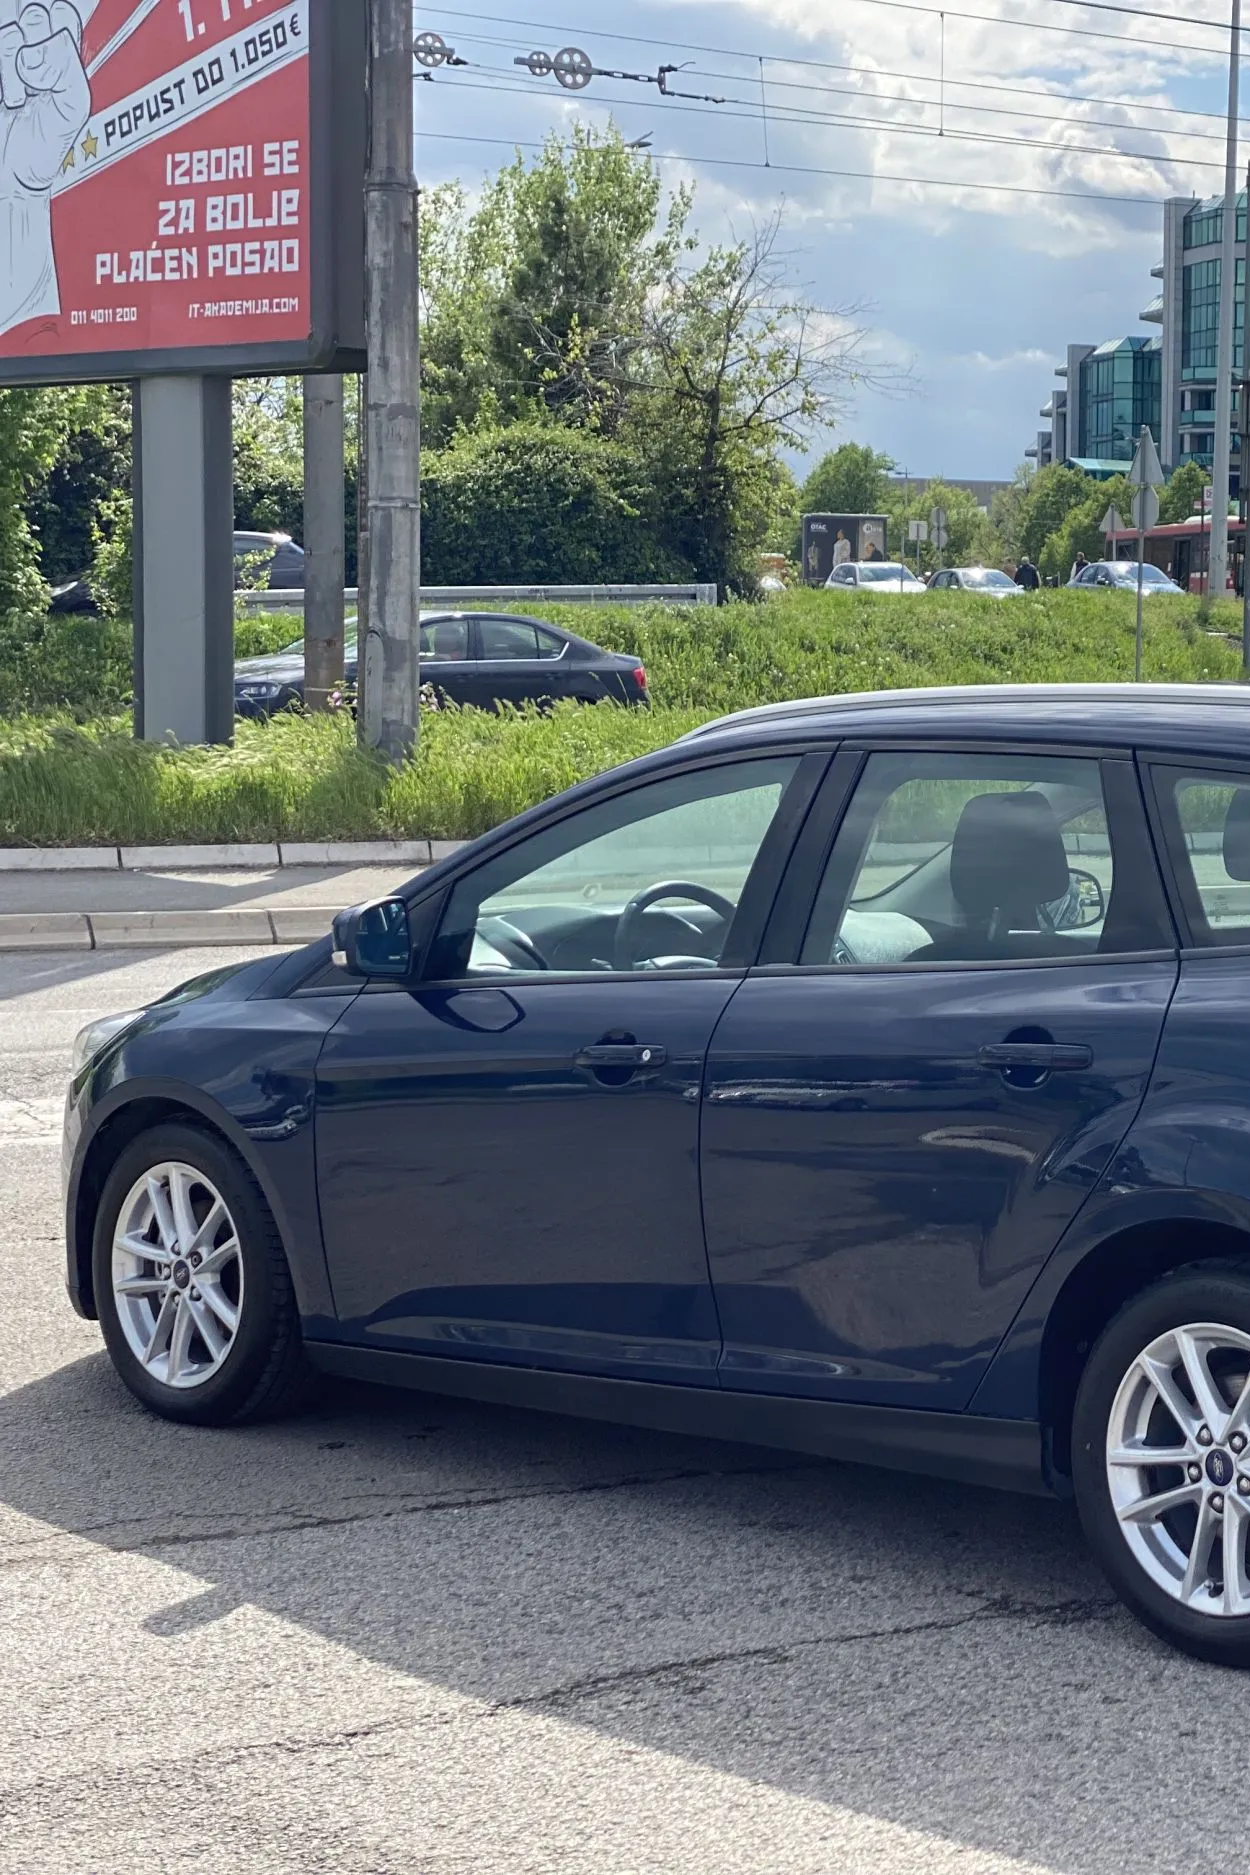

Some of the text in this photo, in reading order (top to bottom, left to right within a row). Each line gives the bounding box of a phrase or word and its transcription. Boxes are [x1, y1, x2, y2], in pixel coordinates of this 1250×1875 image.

[104, 77, 186, 147] POPUST
[192, 56, 225, 96] DO
[166, 140, 300, 186] IZBORI SE
[158, 188, 300, 236] ZA BOLJE
[95, 238, 300, 285] PLAĆEN POSAO
[71, 306, 137, 325] 011 4011 200
[188, 296, 299, 319] IT-AKADEMIJA.COM
